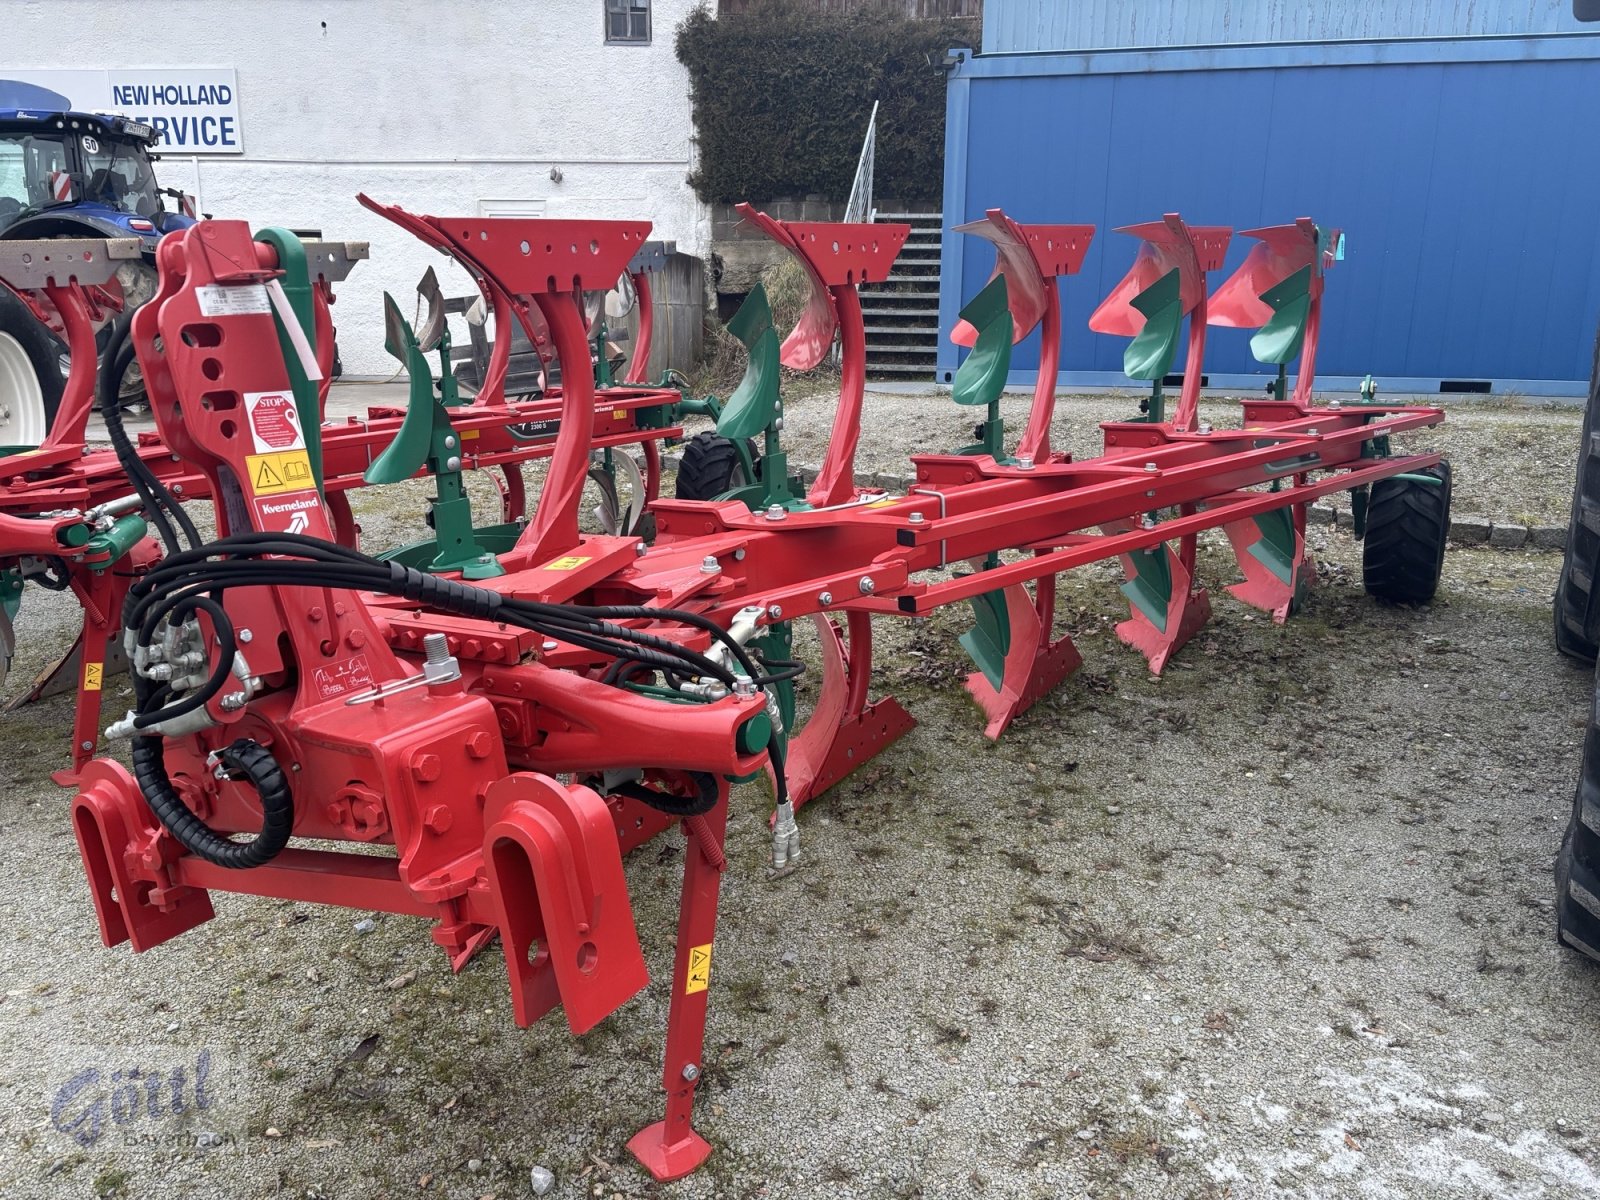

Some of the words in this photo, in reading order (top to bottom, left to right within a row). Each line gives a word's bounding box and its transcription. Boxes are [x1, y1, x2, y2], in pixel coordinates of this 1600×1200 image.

[113, 85, 149, 105] NEW
[152, 84, 232, 105] HOLLAND
[135, 116, 236, 146] RVICE
[84, 139, 98, 151] 50
[260, 397, 286, 408] STOP!
[262, 496, 319, 515] Kverneland
